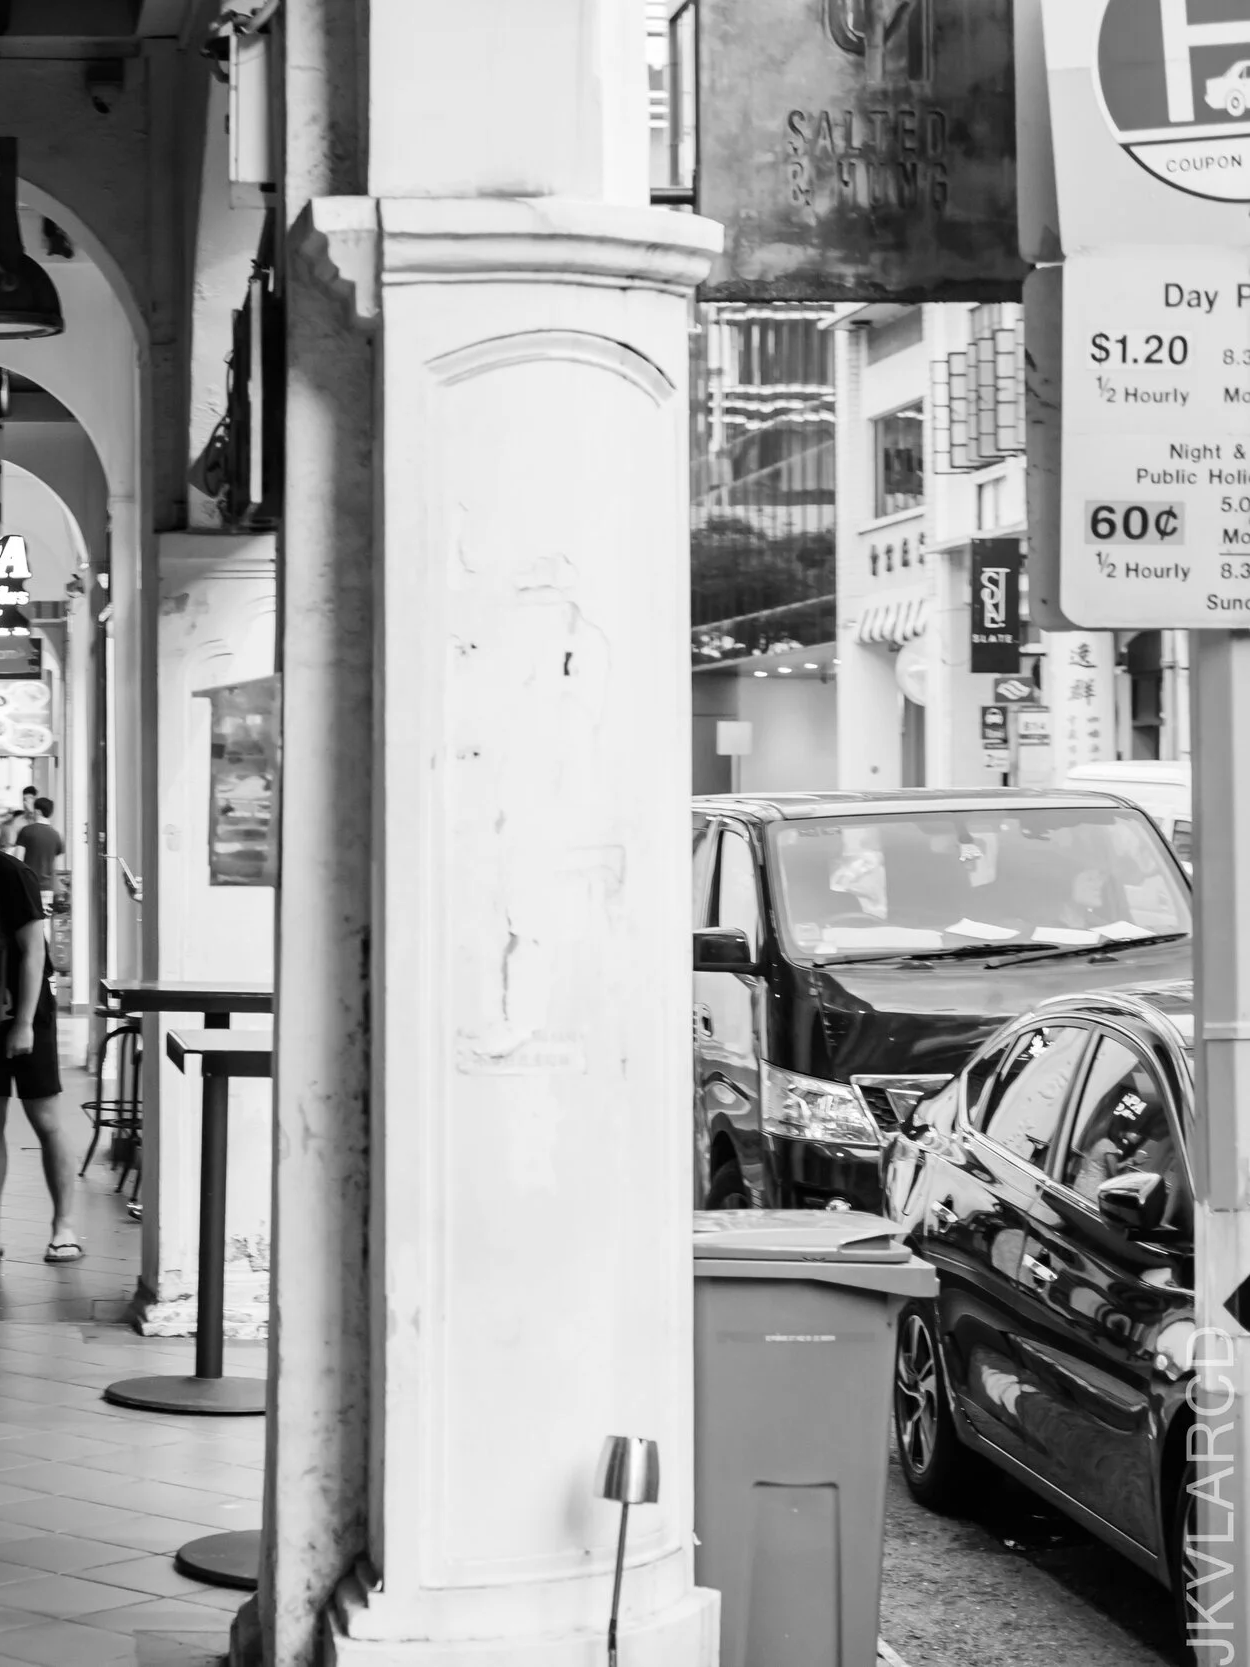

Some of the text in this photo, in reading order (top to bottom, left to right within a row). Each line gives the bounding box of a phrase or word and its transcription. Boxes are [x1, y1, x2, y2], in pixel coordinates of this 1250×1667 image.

[787, 109, 947, 154] SALTED
[1165, 154, 1243, 173] COUPON
[1164, 282, 1219, 314] Day
[1090, 331, 1189, 366] $1.20
[1124, 387, 1190, 407] Hourly
[1170, 443, 1246, 464] Night &
[1136, 468, 1250, 485] Public Holi
[1090, 505, 1179, 541] 60¢
[1125, 562, 1191, 582] Hourly
